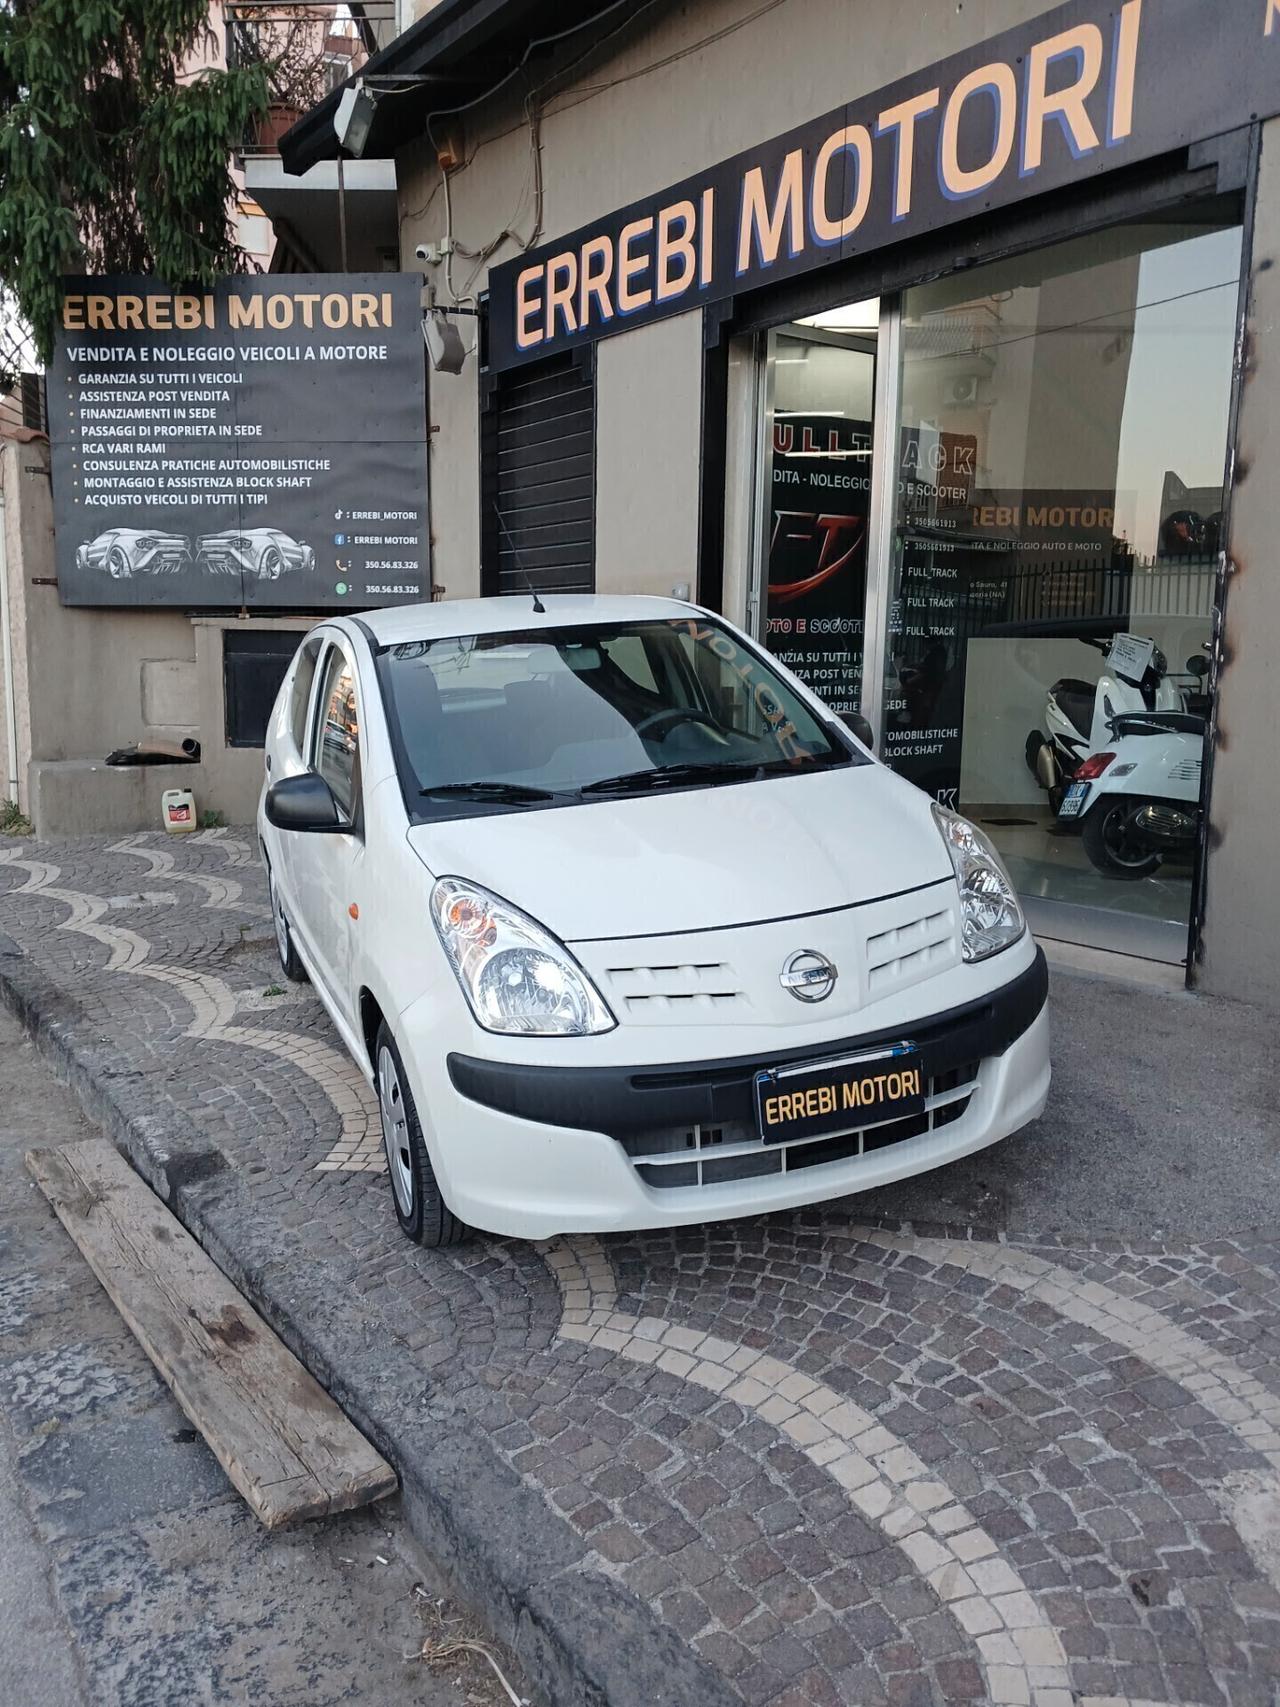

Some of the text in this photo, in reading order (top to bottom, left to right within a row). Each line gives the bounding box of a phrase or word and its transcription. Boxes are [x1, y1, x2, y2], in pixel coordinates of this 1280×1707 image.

[515, 0, 1142, 351] ERREBI MOTORI
[63, 293, 393, 330] ERREBI MOTORI
[67, 345, 387, 361] VENDITA E NOLEGGIO VEICOLI A MOTORE
[78, 372, 243, 384] GARANZIA SU TUTTI I VEICOLI
[79, 390, 230, 401] ASSISTENZA POST VENDITA
[80, 408, 216, 419] FINANZIAMENTI IN SEDE
[81, 425, 262, 436] PASSAGGI DI PROPRIETA IN SEDE
[82, 443, 166, 453] RCA VARI RAMI
[83, 459, 331, 471] CONSULENZA PRATICHE AUTOMOBILISTICHE
[84, 477, 312, 488] MONTAGGIO E ASSISTENZA BLOCK SHAFT
[916, 484, 966, 499] SCOOTER
[85, 494, 268, 507] ACQUISTO VEICOLI DI TUTTI I TIPI
[352, 511, 417, 521] ERREBI_MOTORI
[354, 536, 418, 545] ERREBI MOTORI
[365, 561, 419, 569] 350.56.83.326
[366, 585, 419, 594] 350.56.83.326
[907, 598, 954, 607] FULL TRACK
[796, 618, 806, 634] E
[807, 652, 820, 662] SU
[822, 652, 850, 662] TUTTI
[813, 669, 839, 679] POST
[834, 685, 845, 695] IN
[886, 728, 958, 741] OMOBILISTICHE
[915, 744, 943, 755] SHAFT
[765, 1069, 920, 1125] ERREBI MOTORI
